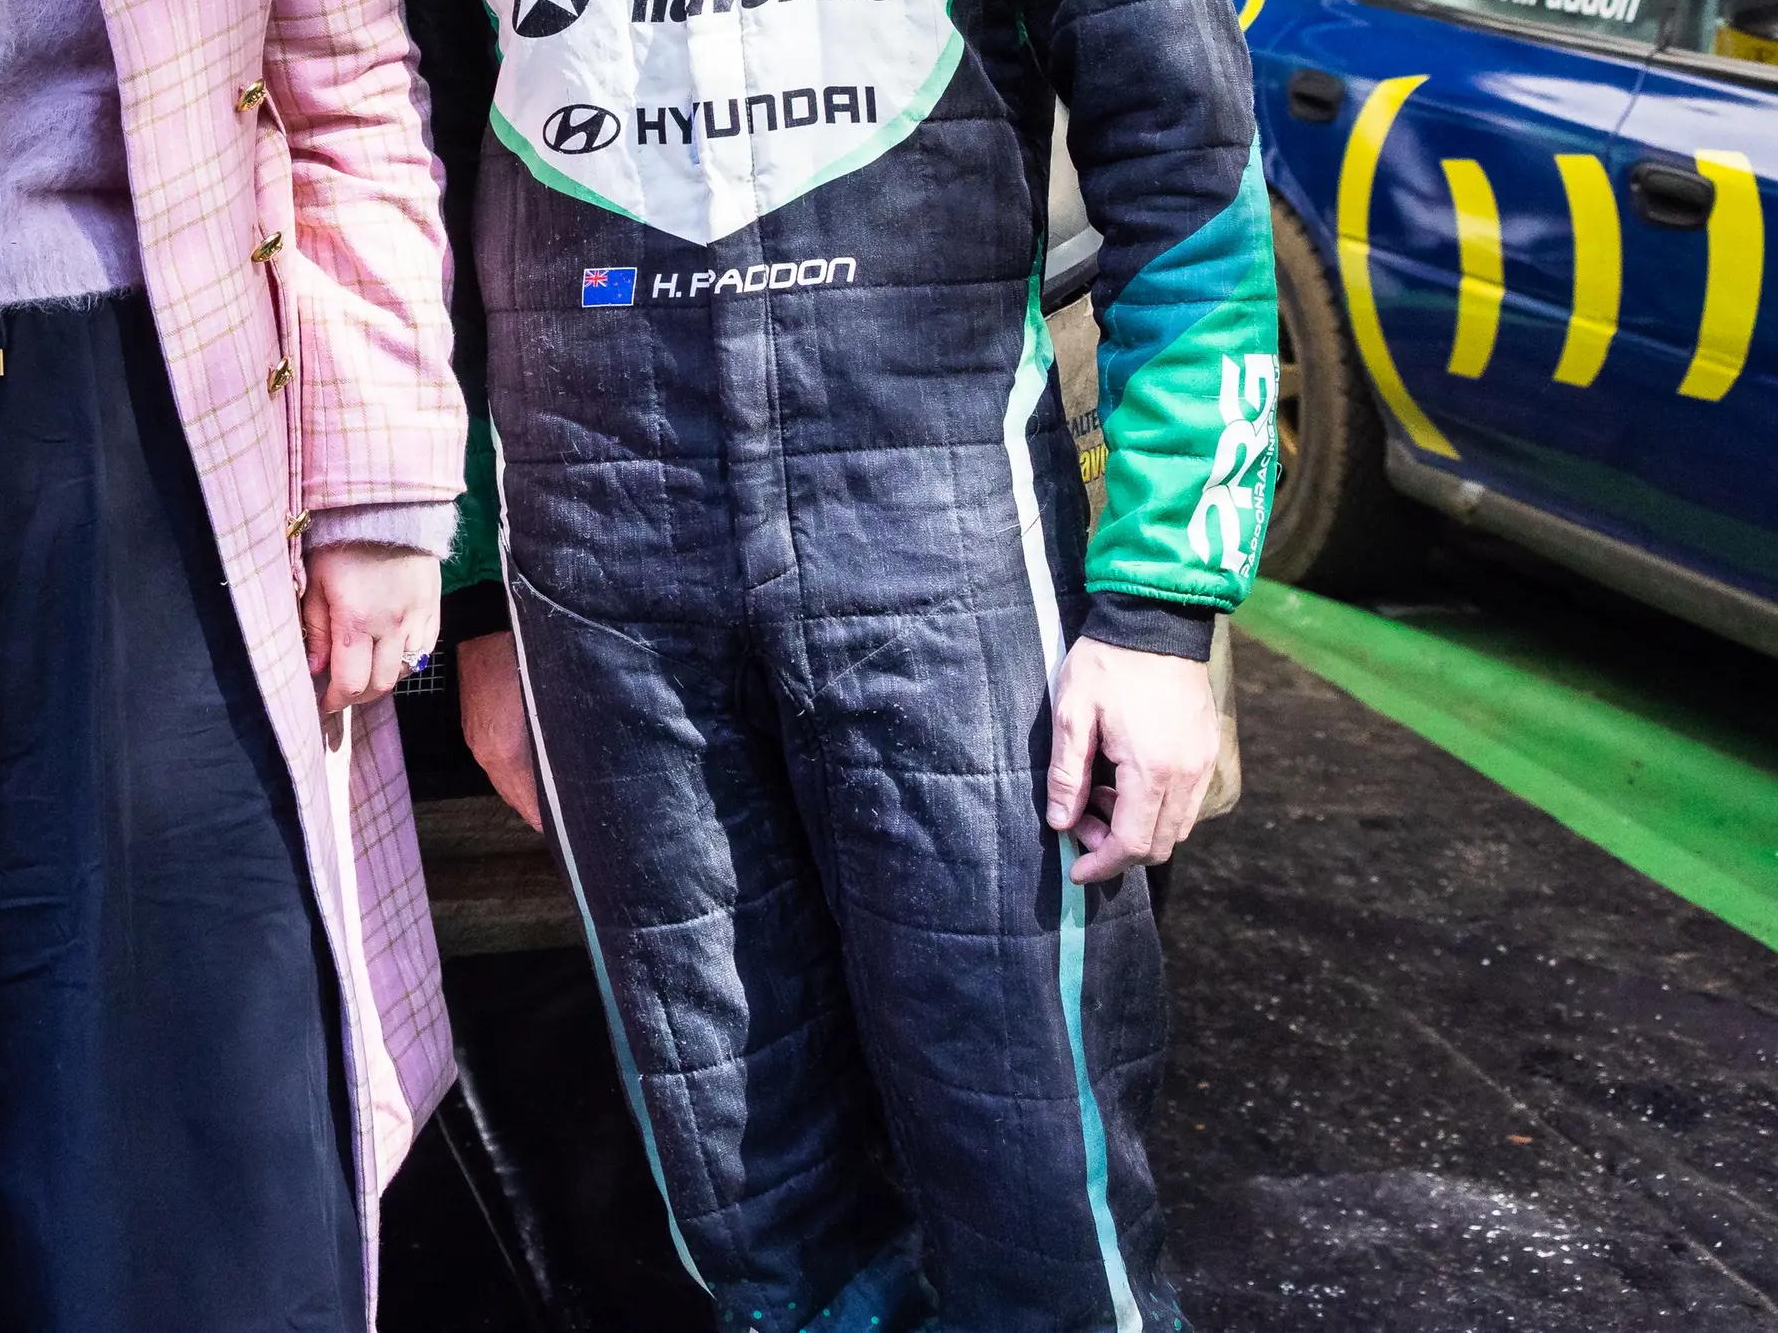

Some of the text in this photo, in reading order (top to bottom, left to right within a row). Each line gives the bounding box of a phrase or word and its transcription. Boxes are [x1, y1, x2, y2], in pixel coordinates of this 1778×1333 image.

[635, 85, 878, 145] HYUNDAI
[651, 256, 857, 298] H. PADDON
[1187, 353, 1277, 575] PRG
